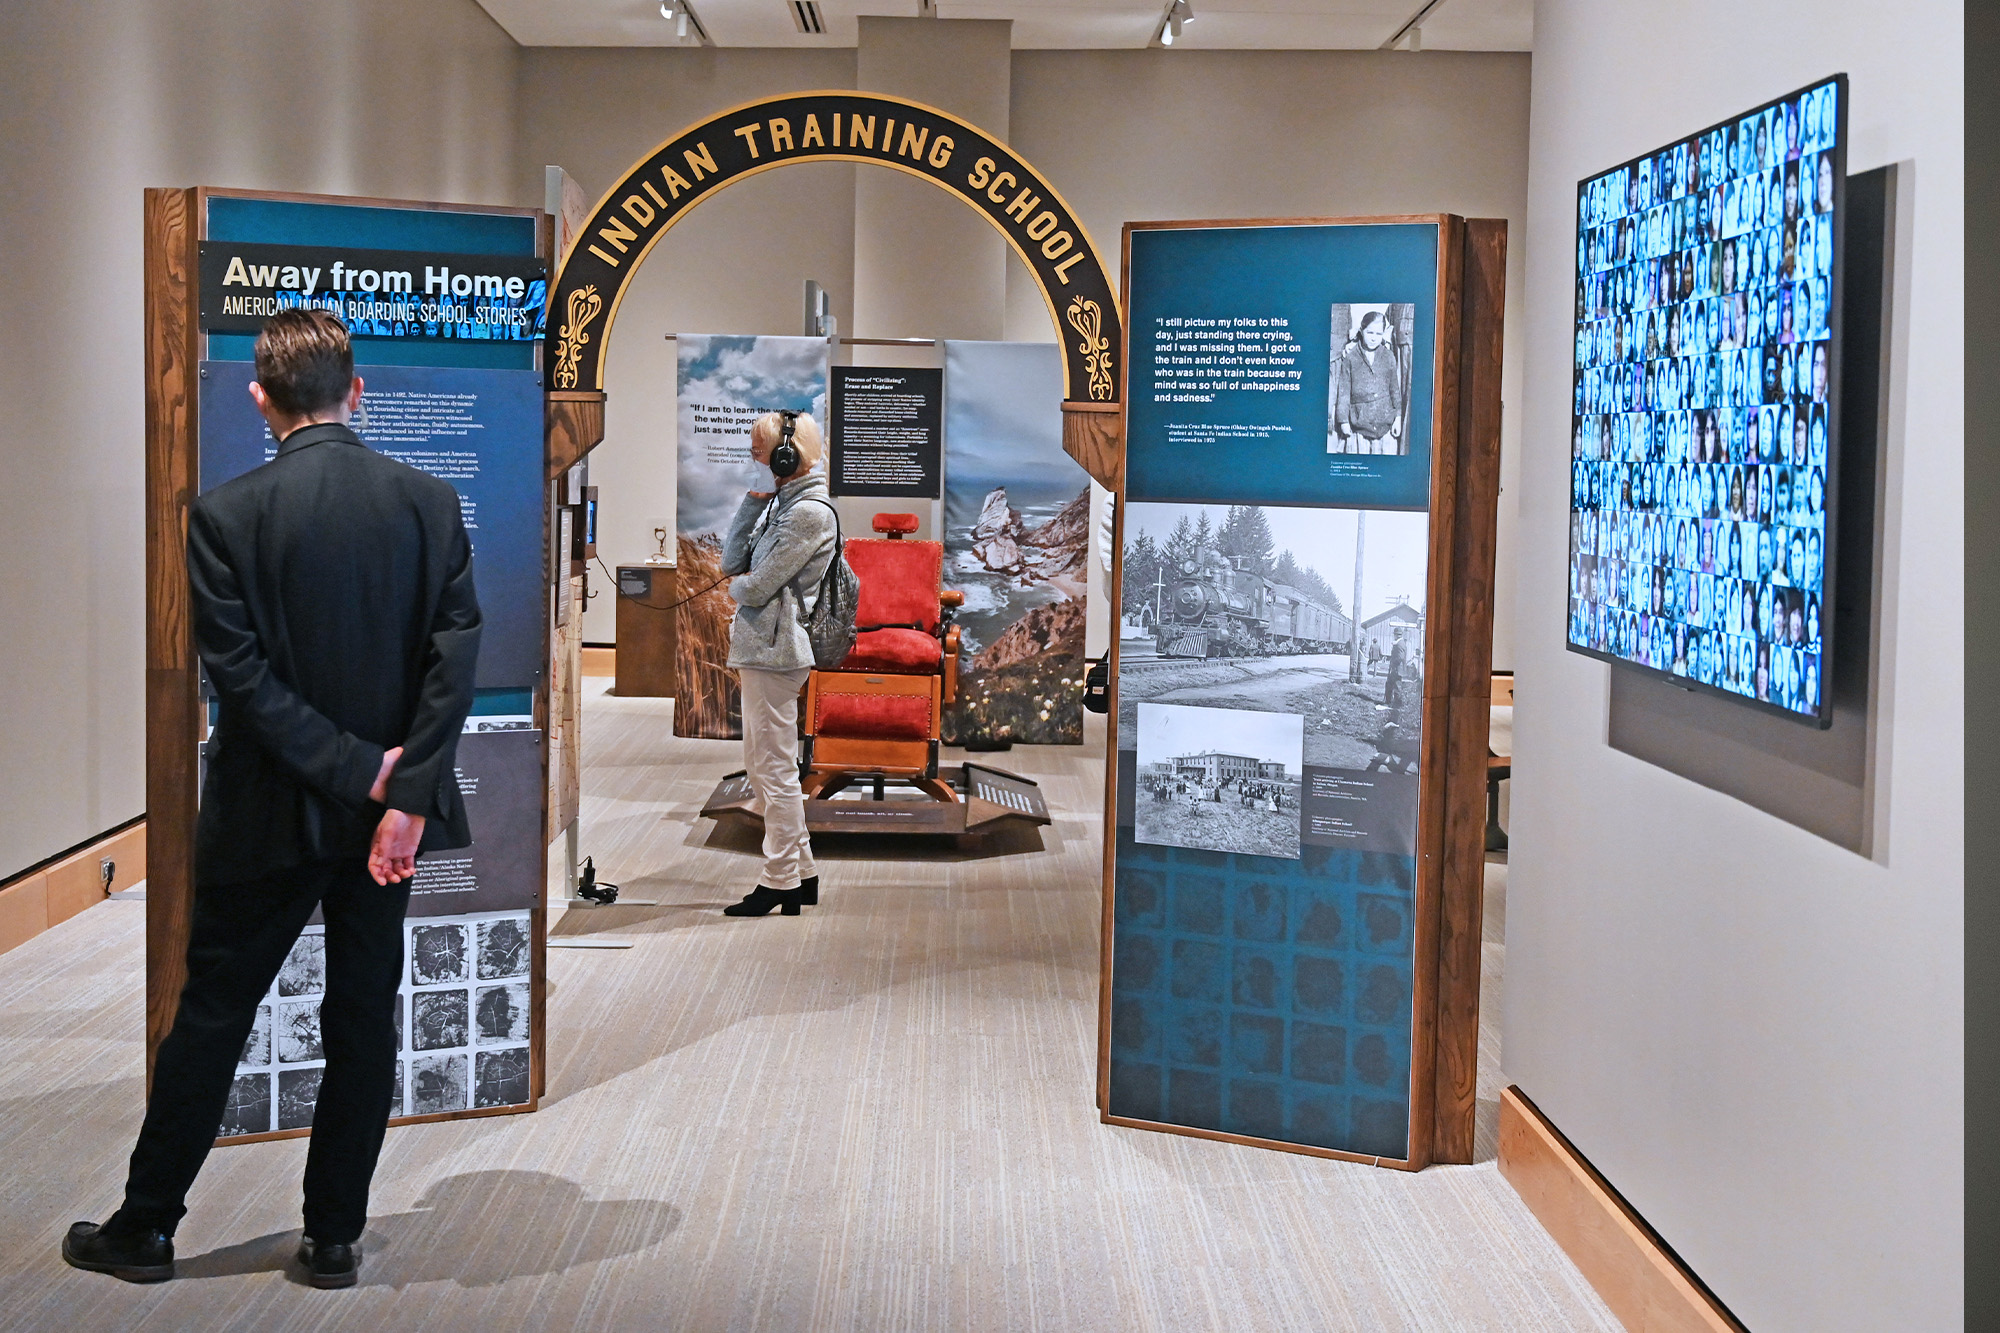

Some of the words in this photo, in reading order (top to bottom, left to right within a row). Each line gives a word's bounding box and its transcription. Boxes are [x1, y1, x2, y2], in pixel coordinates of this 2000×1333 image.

[588, 142, 719, 268] INDIAN
[734, 113, 955, 169] TRAINING
[968, 157, 1085, 285] SCHOOL
[222, 256, 321, 295] Away
[330, 261, 412, 293] from
[425, 265, 525, 299] Home
[222, 296, 292, 316] AMERICAN
[348, 301, 415, 322] BOARDING
[420, 303, 470, 324] SCHOOL
[476, 306, 527, 326] STORIES
[1156, 318, 1163, 326] “I
[1166, 318, 1182, 326] still
[1184, 318, 1215, 328] picture
[1218, 320, 1231, 328] my
[1234, 318, 1256, 326] folks
[1271, 318, 1288, 326] this
[1156, 331, 1173, 340] day,
[1175, 331, 1192, 340] just
[1195, 331, 1233, 341] standing
[1236, 331, 1260, 339] there
[1263, 331, 1293, 341] crying,
[1174, 344, 1177, 352] I
[1200, 344, 1234, 353] missing
[1271, 345, 1286, 353] got
[1195, 356, 1211, 364] and
[1214, 356, 1216, 364] I
[1219, 356, 1242, 364] don’t
[1269, 356, 1294, 364] know
[1207, 369, 1221, 377] the
[1224, 369, 1244, 377] train
[1247, 369, 1285, 377] because
[1288, 371, 1302, 379] my
[1212, 381, 1226, 389] full
[1241, 382, 1300, 392] unhappiness
[1173, 394, 1215, 402] sadness.”
